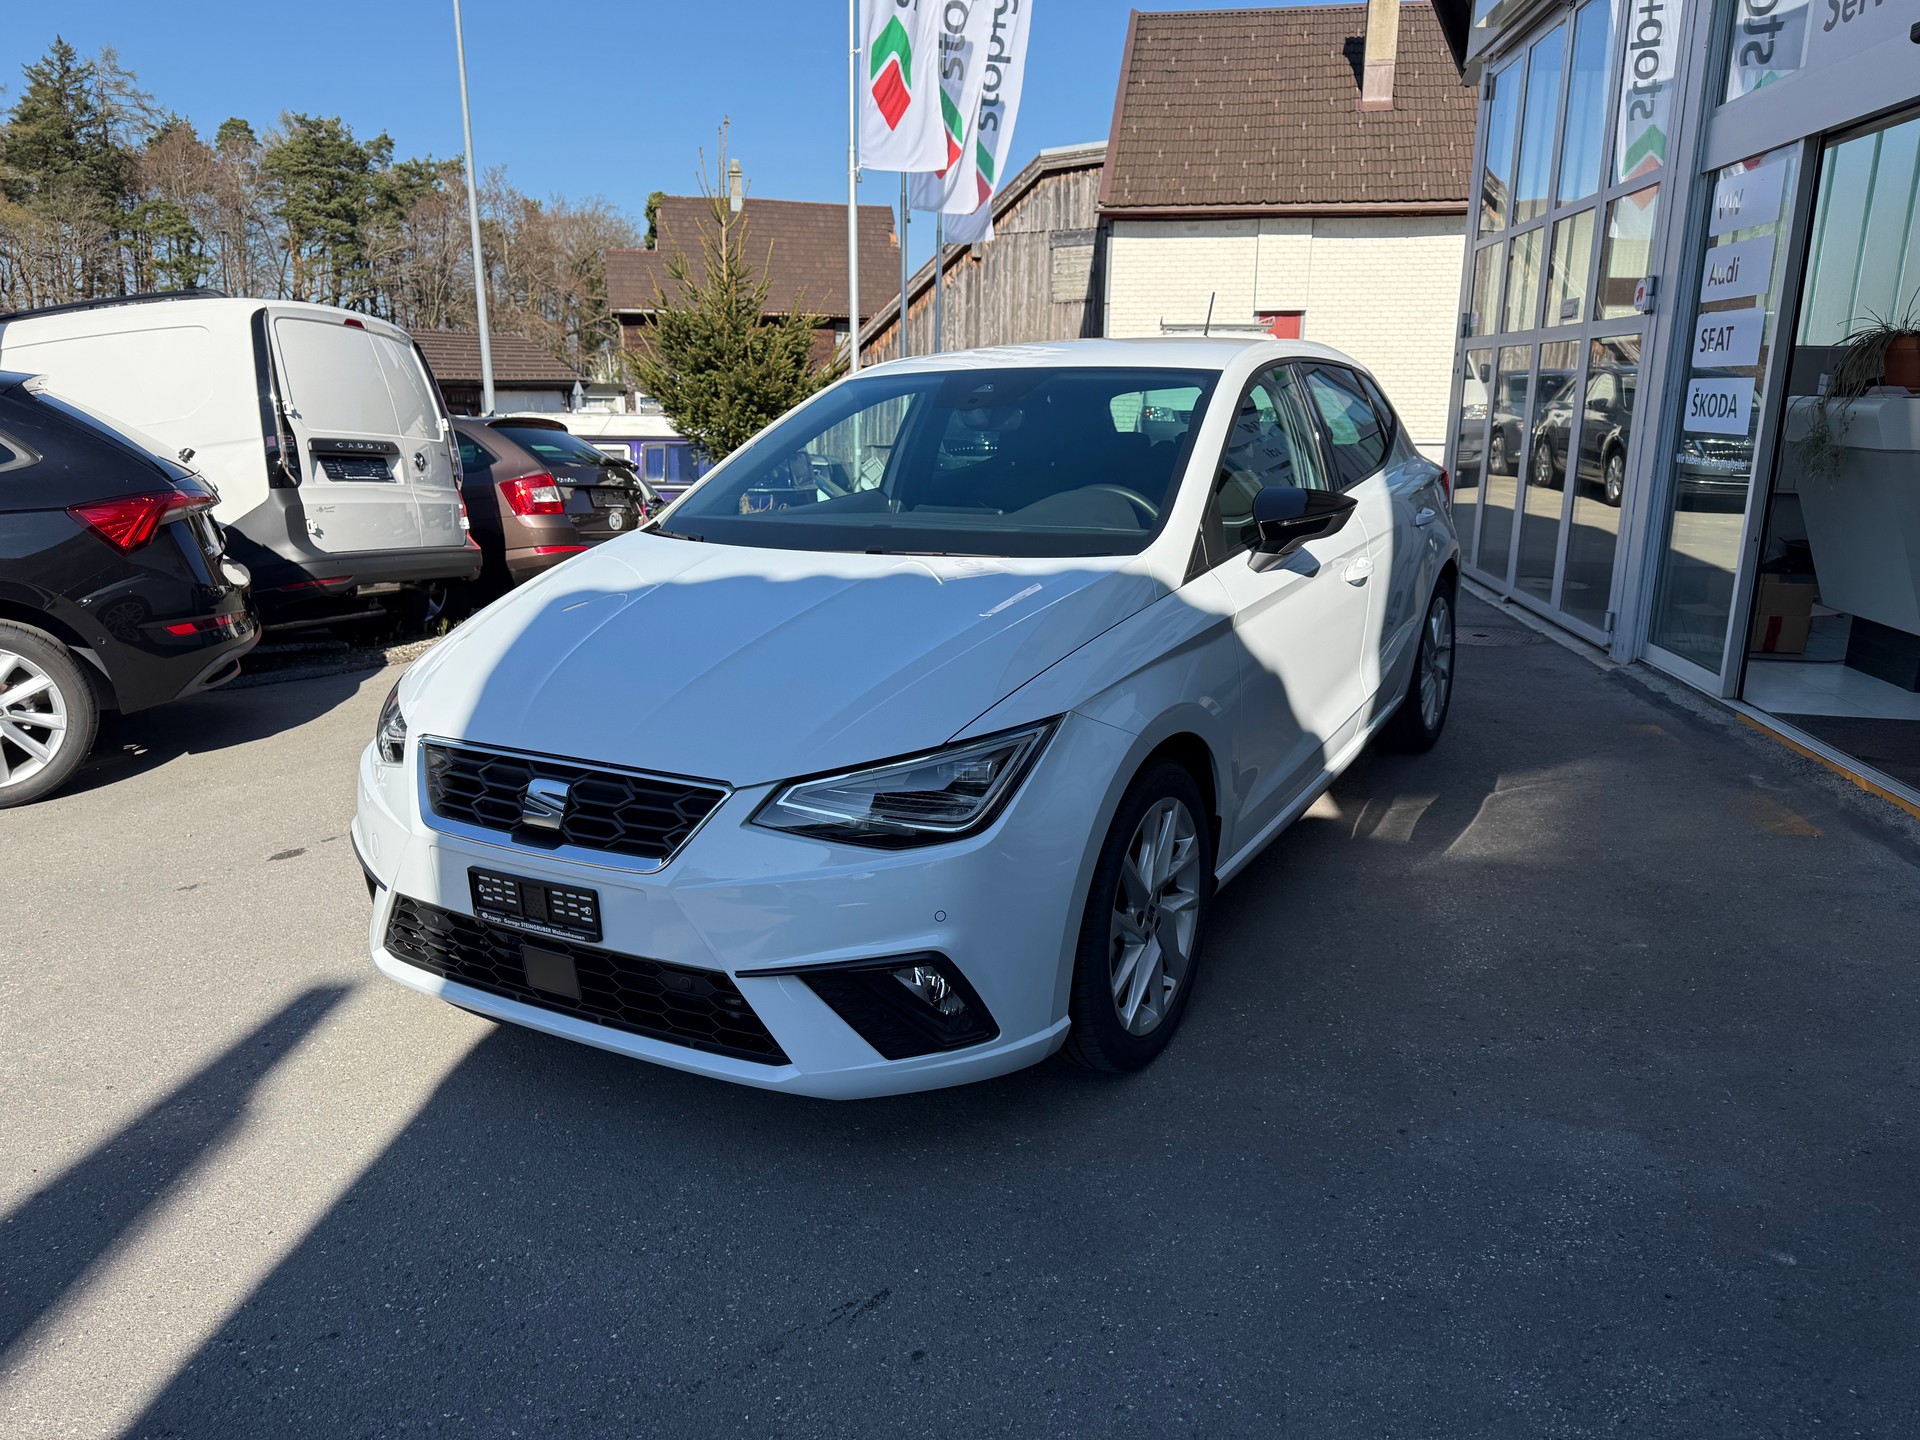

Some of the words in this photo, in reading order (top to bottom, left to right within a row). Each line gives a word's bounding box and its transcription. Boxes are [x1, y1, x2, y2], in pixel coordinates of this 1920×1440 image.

[939, 0, 969, 81] sto
[1707, 256, 1741, 287] Audi
[1700, 325, 1735, 353] SEAT
[1690, 387, 1738, 419] ŠKODA
[335, 441, 382, 450] CADDY
[611, 514, 620, 528] CH
[503, 918, 520, 927] Garage
